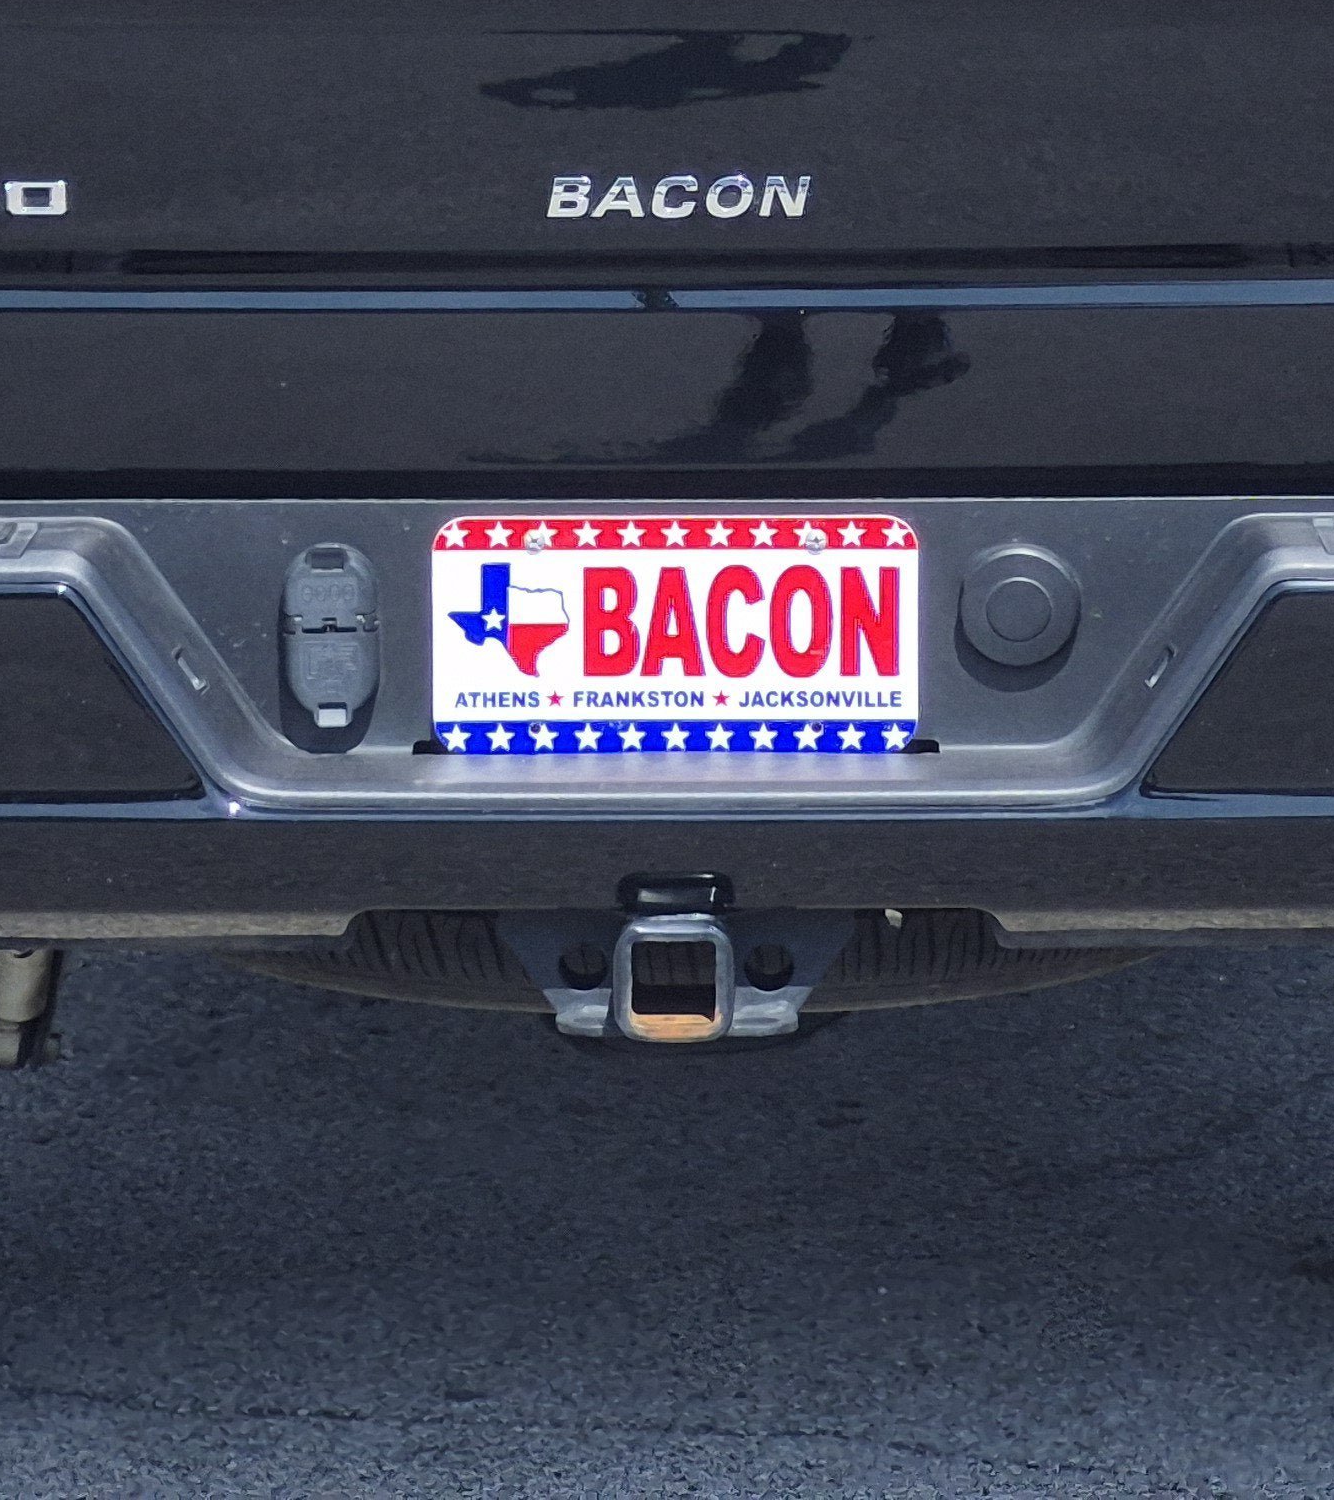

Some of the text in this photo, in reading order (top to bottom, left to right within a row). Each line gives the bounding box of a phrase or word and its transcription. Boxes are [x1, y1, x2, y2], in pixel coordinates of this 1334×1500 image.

[546, 174, 812, 219] BACON
[582, 565, 901, 678] BACON
[454, 690, 903, 709] ATHENS FRANKSTON JACKSONVILLE
